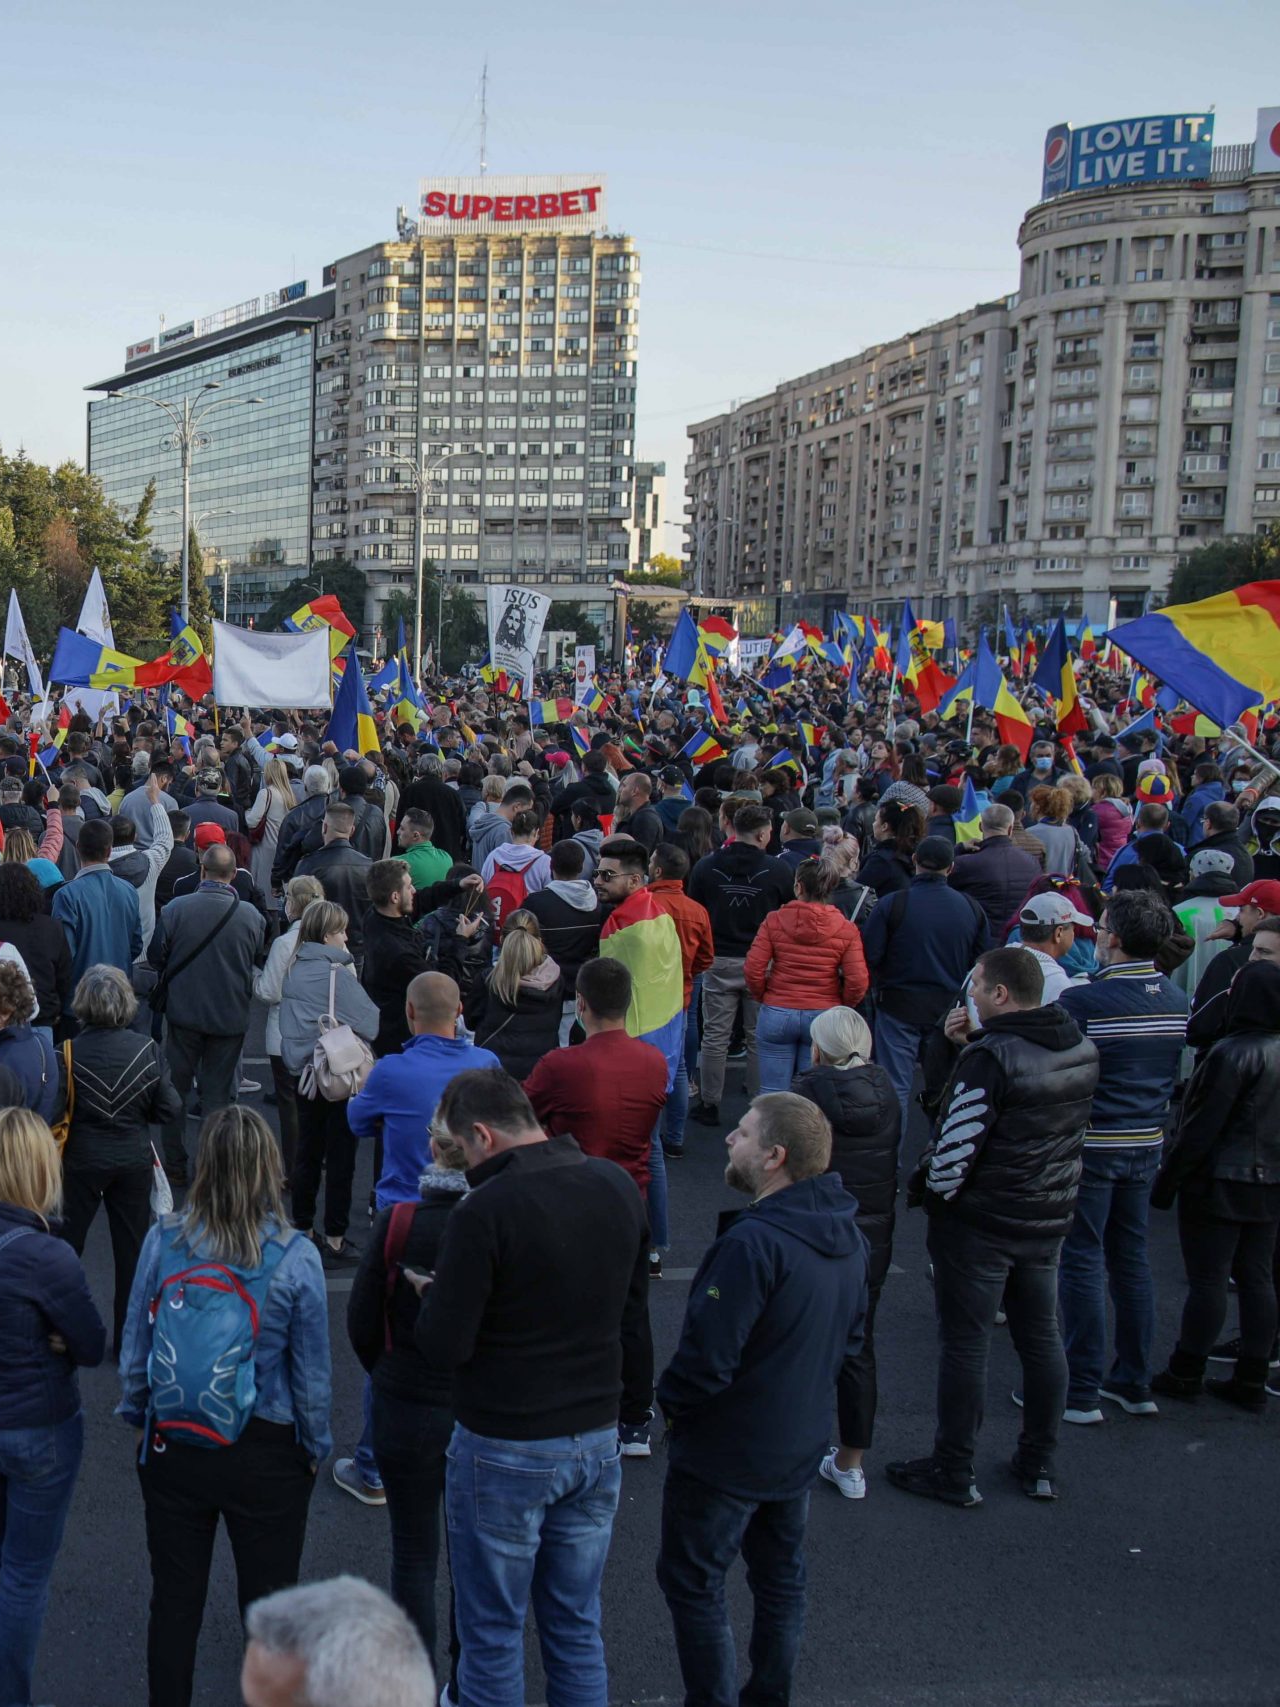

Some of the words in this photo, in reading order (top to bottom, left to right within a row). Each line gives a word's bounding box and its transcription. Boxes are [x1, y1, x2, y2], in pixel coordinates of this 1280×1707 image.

[1079, 120, 1164, 156] LOVE
[1173, 117, 1211, 143] IT.
[1077, 151, 1146, 185] LIVE
[1156, 147, 1195, 174] IT.
[423, 186, 602, 221] SUPERBET
[504, 589, 541, 609] ISUS
